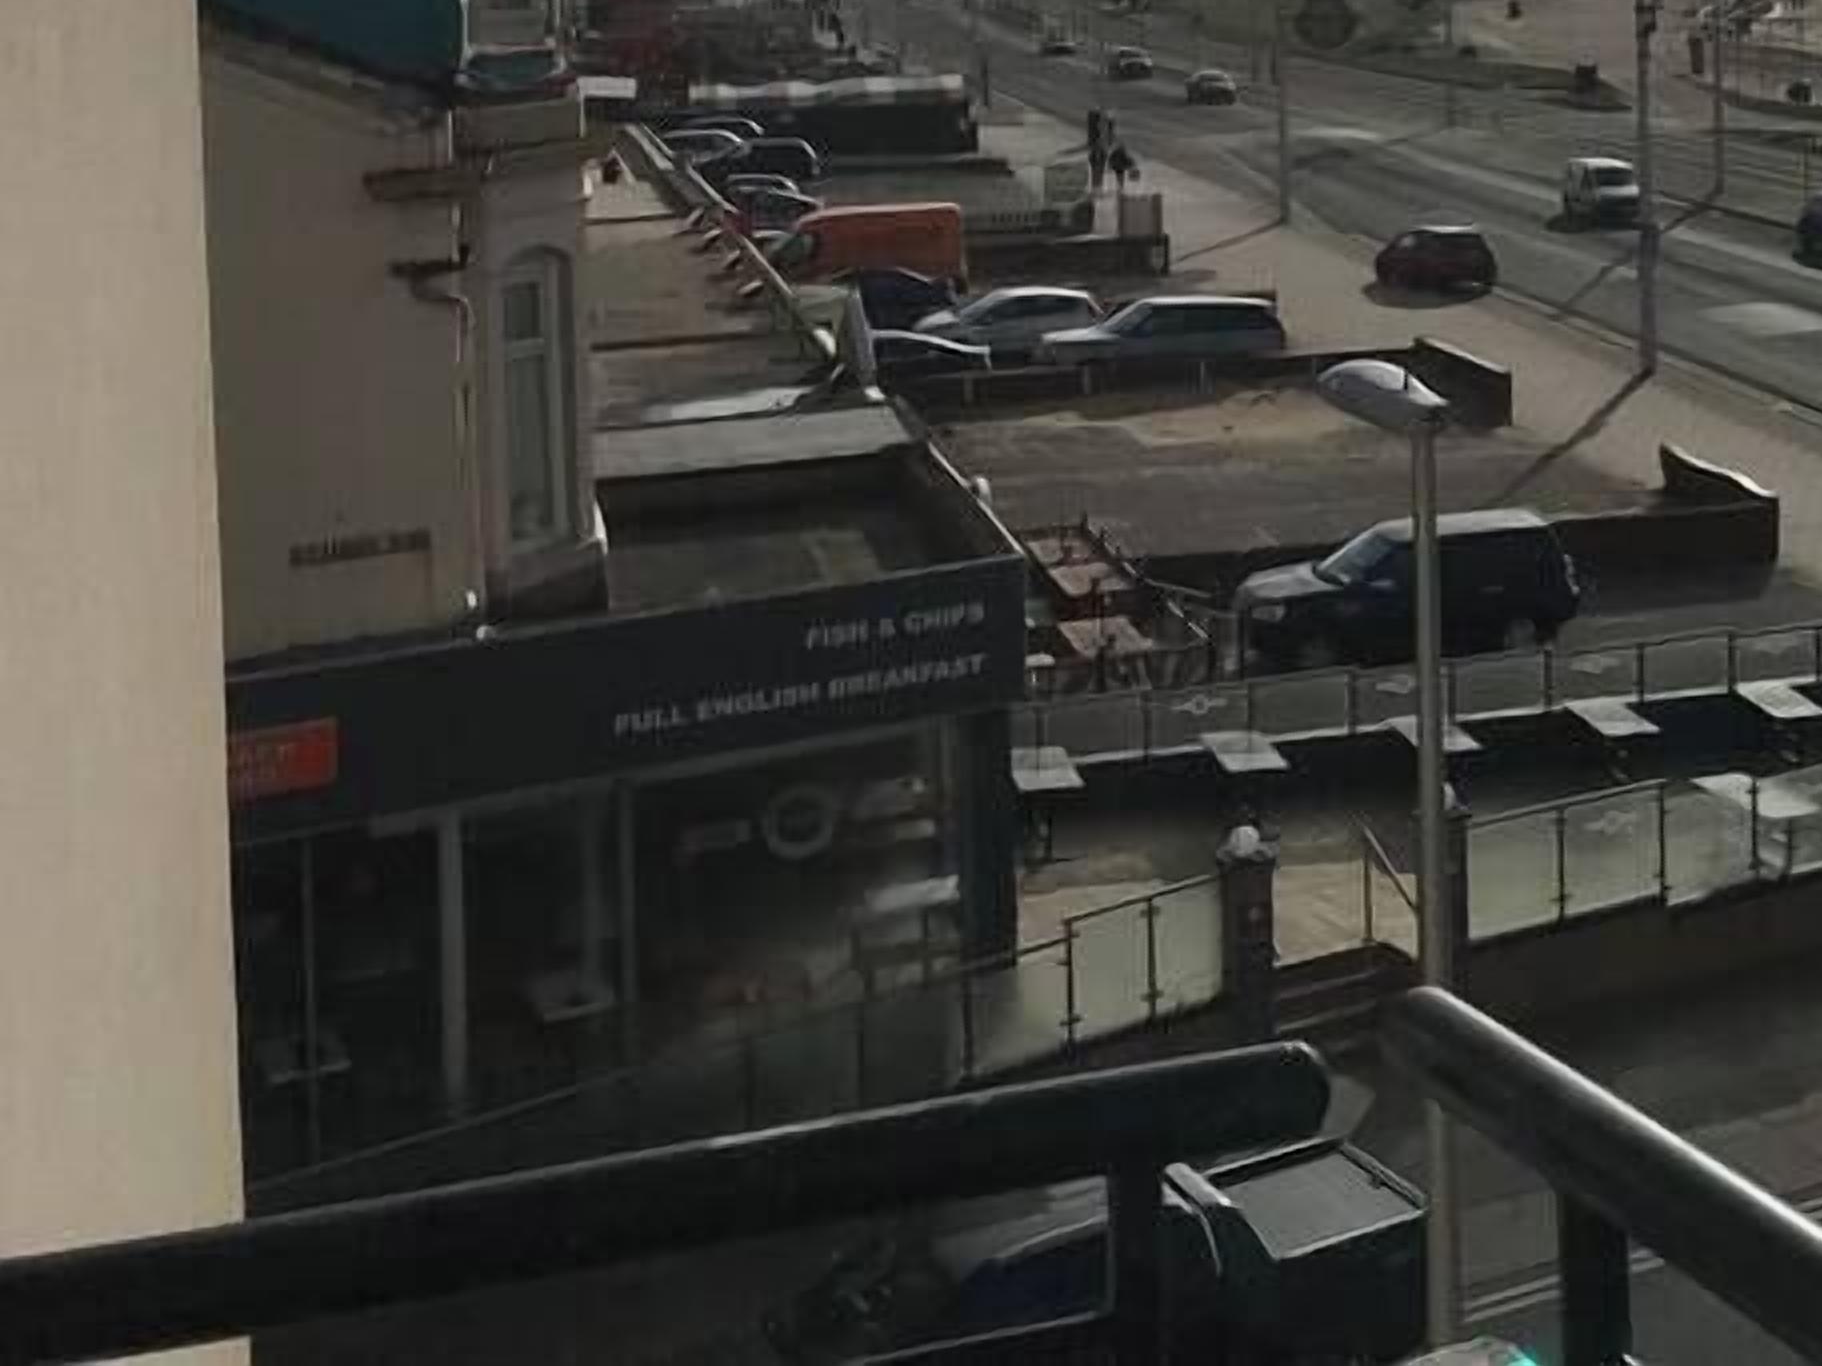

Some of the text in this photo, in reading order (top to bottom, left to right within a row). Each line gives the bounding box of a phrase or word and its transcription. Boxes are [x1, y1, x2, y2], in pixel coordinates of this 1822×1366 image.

[806, 619, 869, 650] FISH
[904, 602, 985, 634] CHIPS
[614, 652, 988, 736] FULL ENGLISH BREAKFAST
